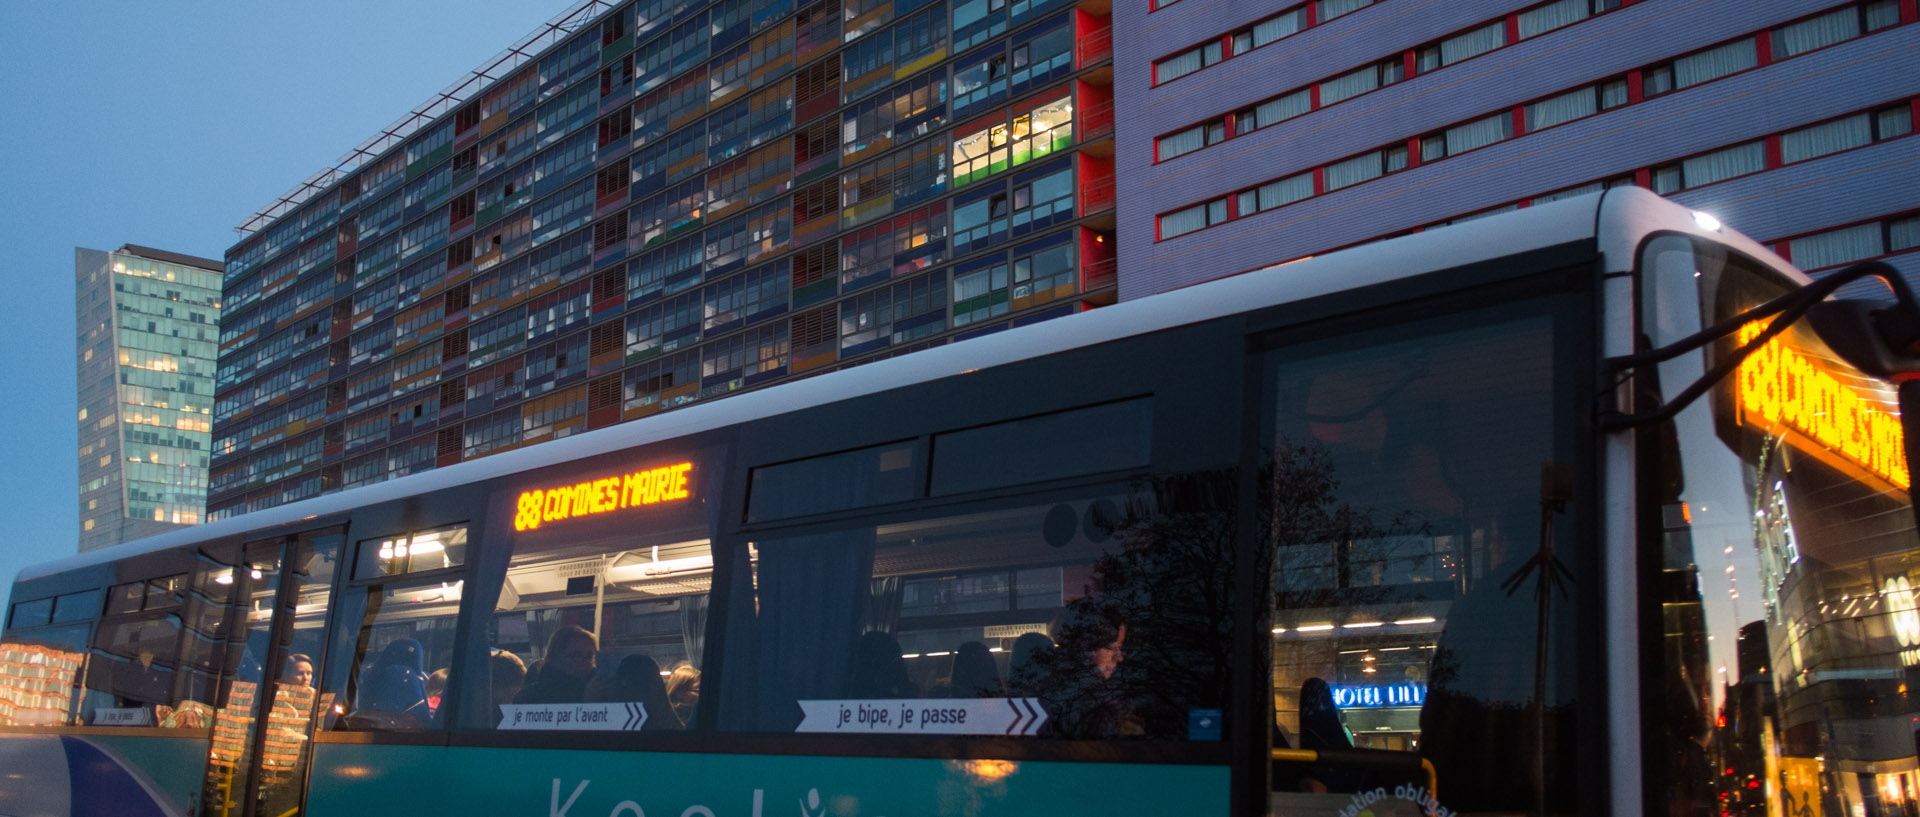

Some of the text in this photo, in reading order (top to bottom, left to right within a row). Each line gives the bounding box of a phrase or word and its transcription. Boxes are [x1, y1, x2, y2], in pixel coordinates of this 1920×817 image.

[514, 462, 692, 532] 88 COMINES MAIRIE
[512, 707, 608, 726] je monte par l'avant
[836, 704, 967, 729] je bipe, je passe
